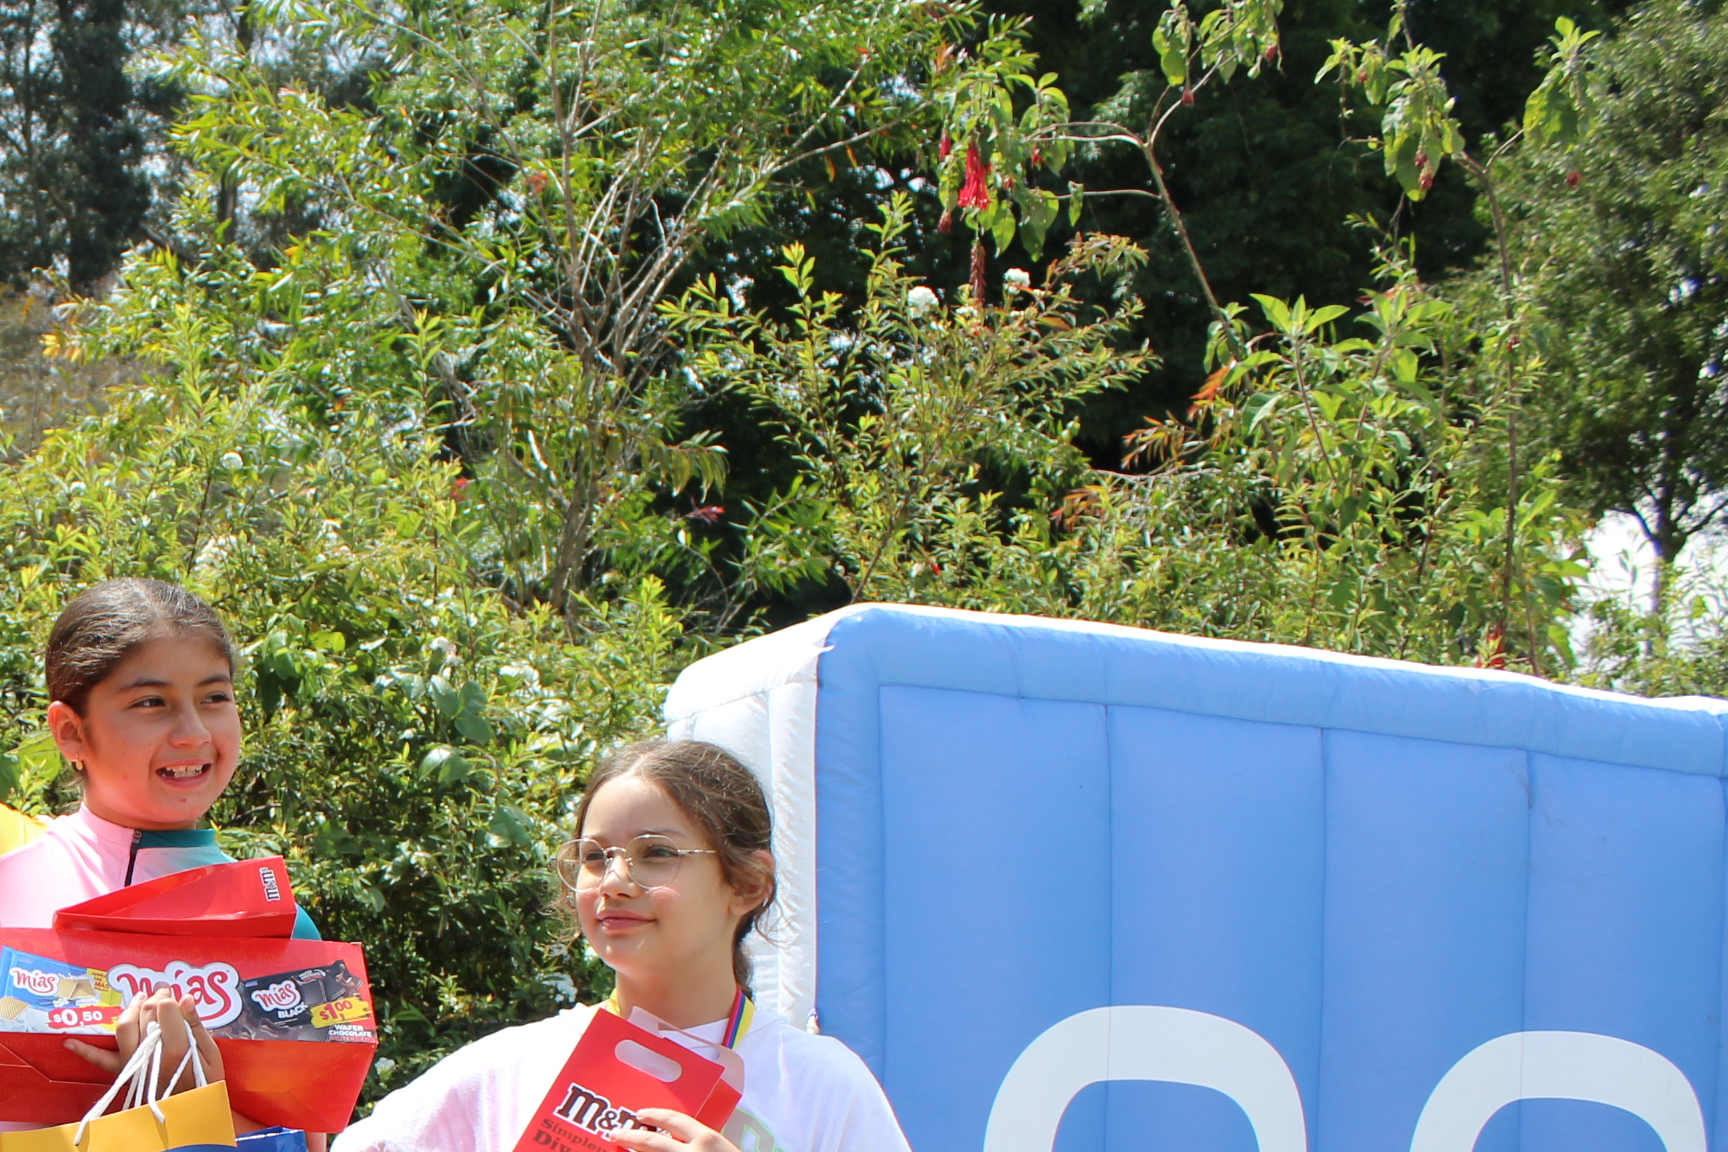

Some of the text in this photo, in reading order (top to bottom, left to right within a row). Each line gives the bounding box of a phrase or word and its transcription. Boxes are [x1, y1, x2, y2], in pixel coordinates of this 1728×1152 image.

[277, 1001, 308, 1019] BLACK
[333, 1024, 364, 1032] WAFER
[328, 1030, 372, 1038] CHOCOLATE
